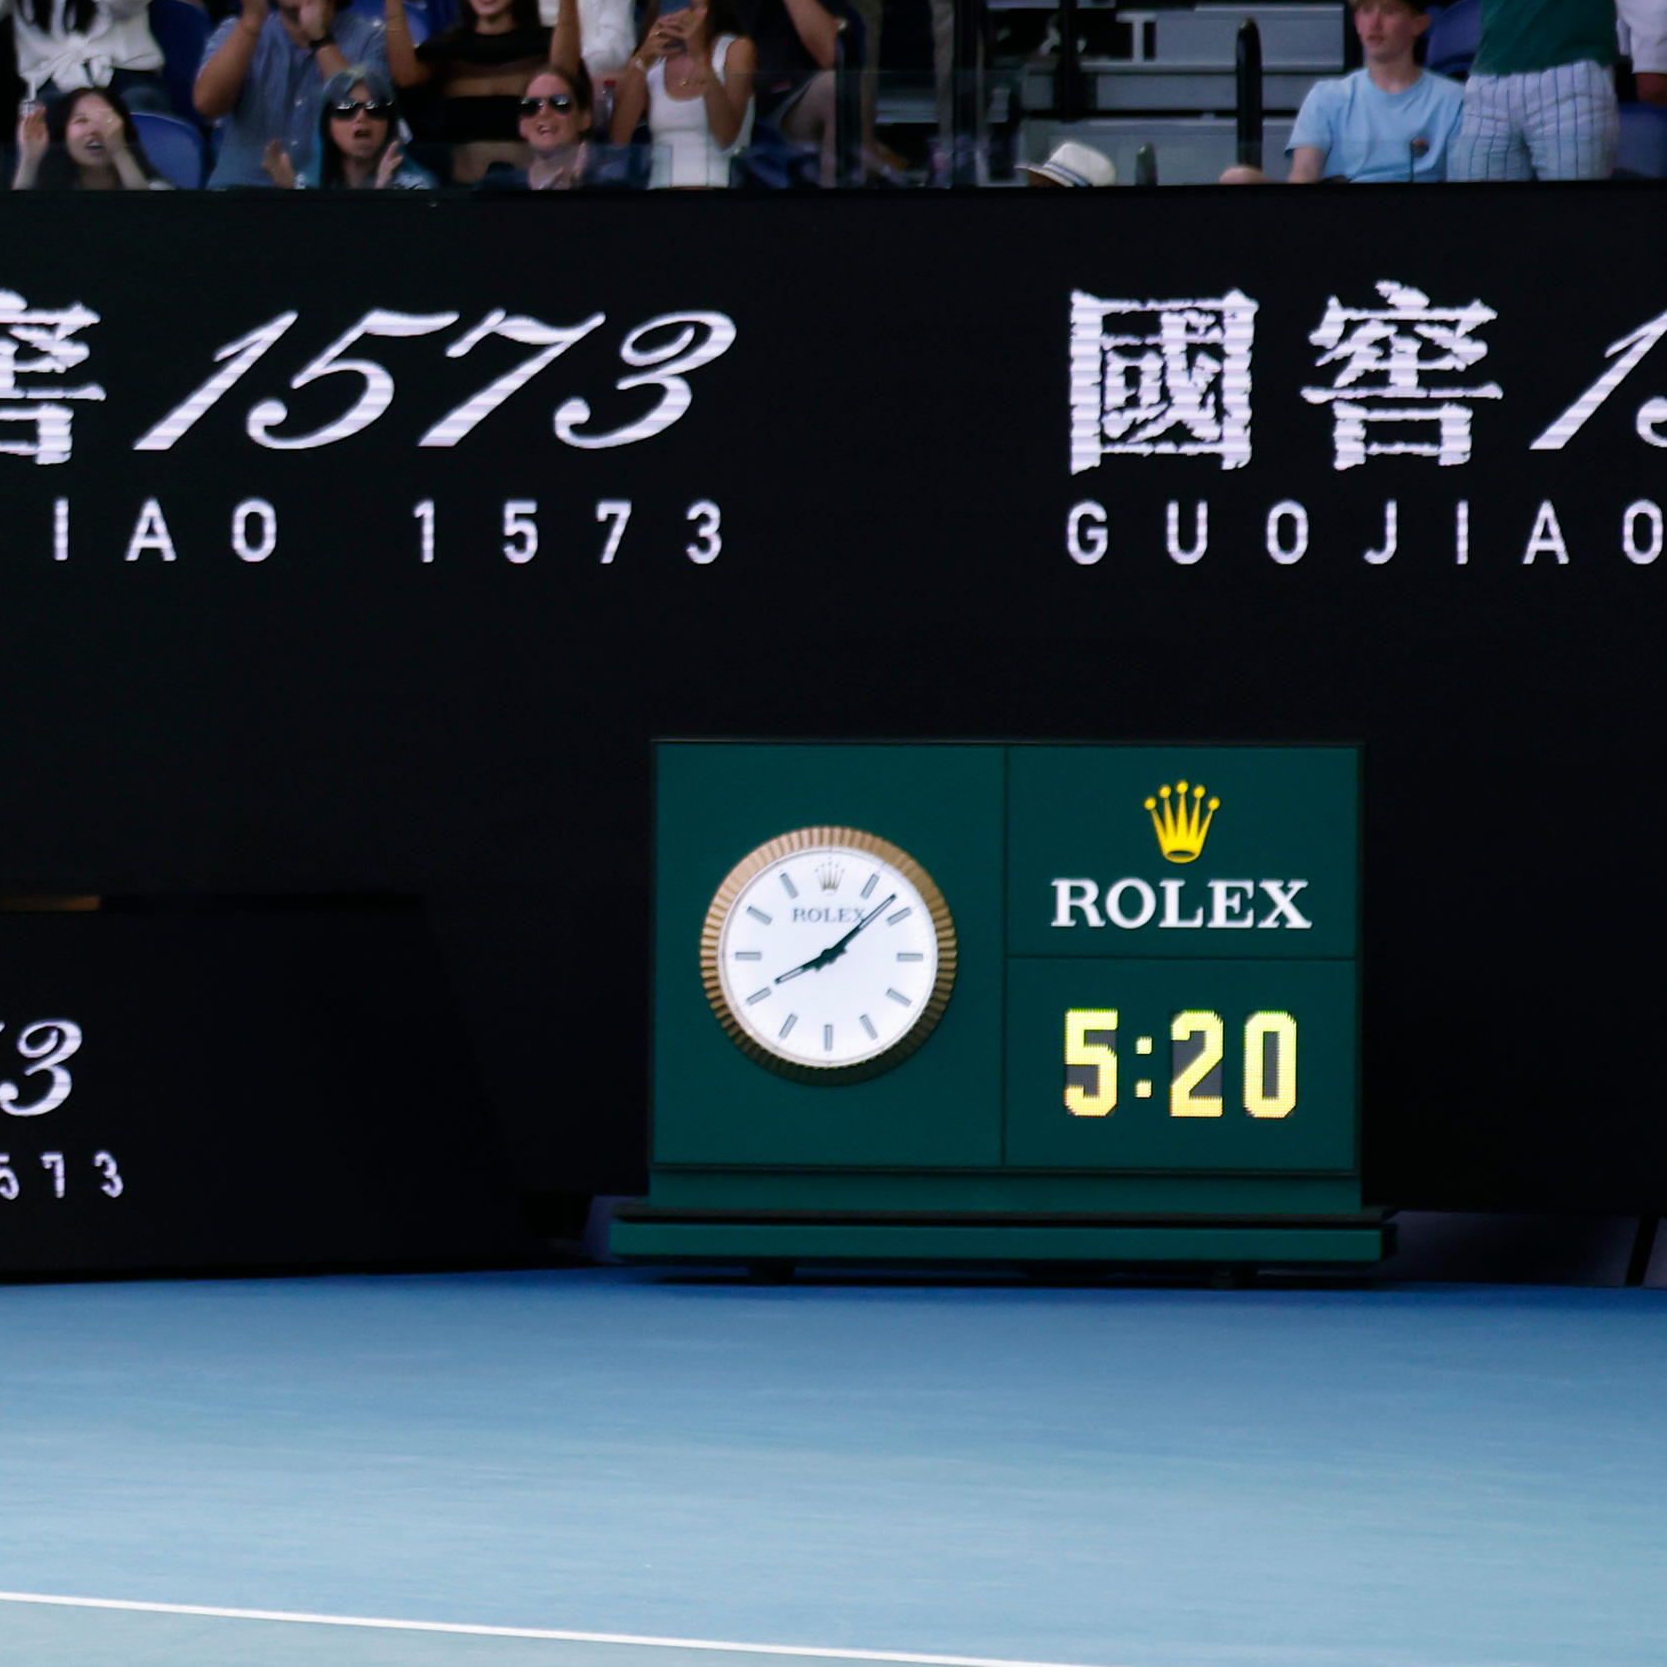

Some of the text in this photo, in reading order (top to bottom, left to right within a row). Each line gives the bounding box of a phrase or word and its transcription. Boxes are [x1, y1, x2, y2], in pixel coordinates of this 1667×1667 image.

[1069, 280, 1667, 475] 國窖1
[413, 499, 723, 565] 1573
[1065, 498, 1664, 565] GUOJIAO
[792, 907, 866, 923] ROLEX
[1050, 877, 1312, 930] ROLEX
[1065, 1009, 1297, 1119] 5:20
